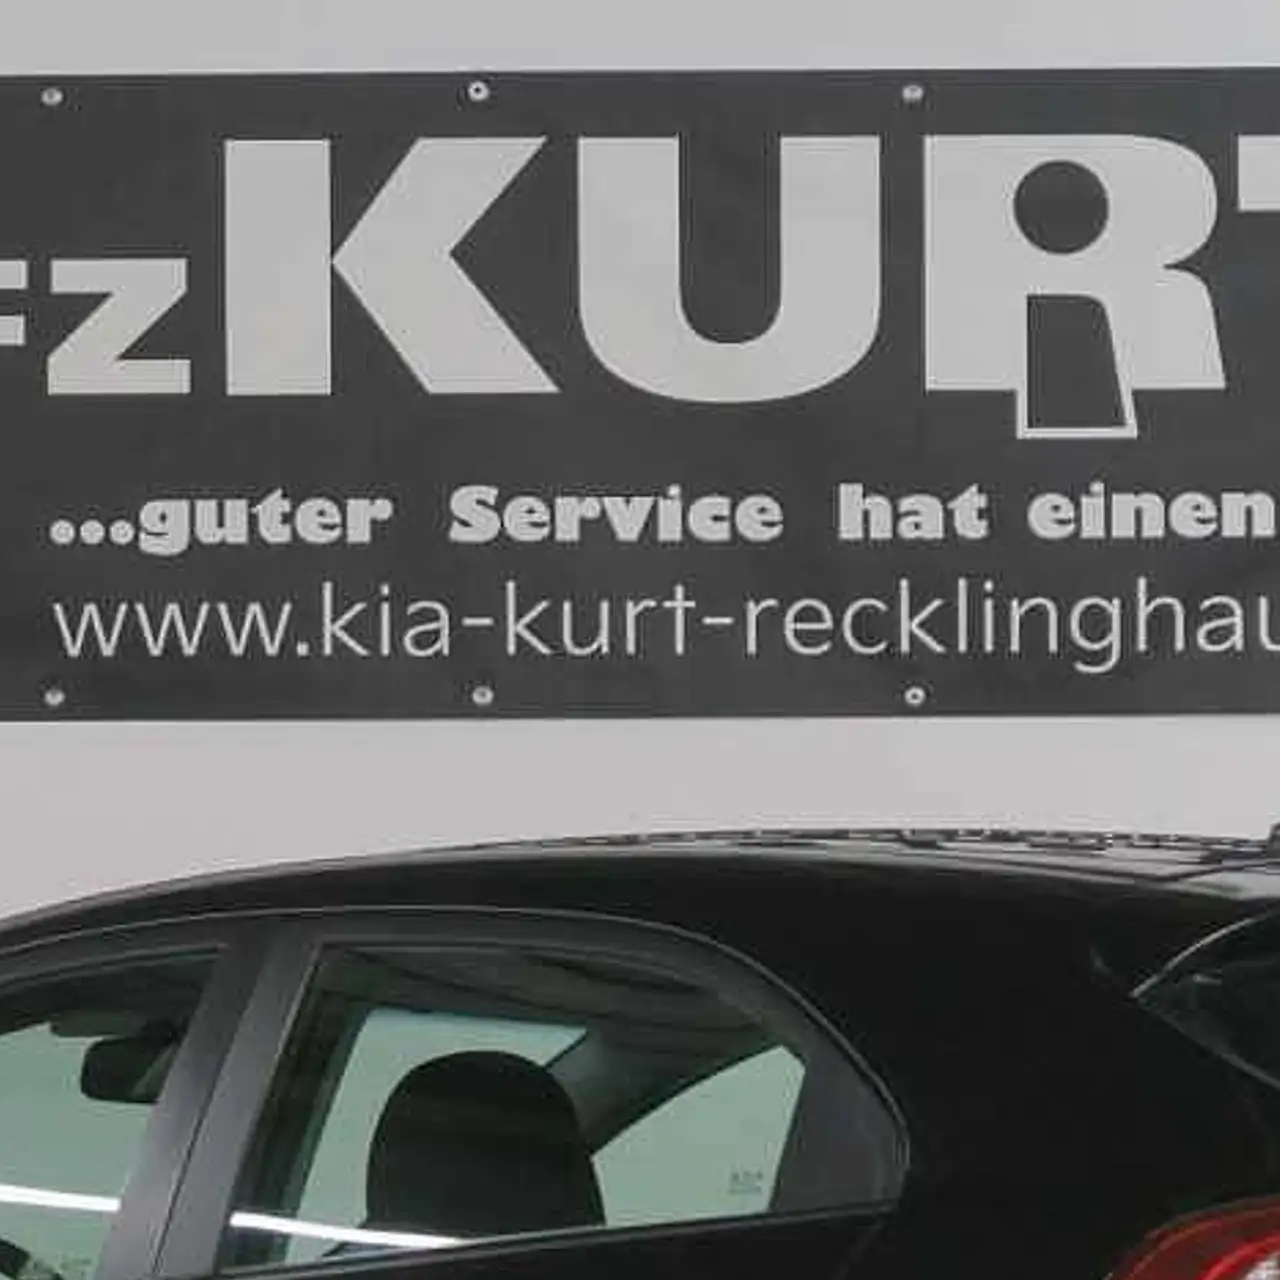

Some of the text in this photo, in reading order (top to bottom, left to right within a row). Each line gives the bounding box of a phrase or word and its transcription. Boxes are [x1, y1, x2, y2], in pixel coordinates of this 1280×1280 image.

[49, 488, 393, 556] ...guter
[448, 484, 784, 543] Service
[838, 482, 990, 541] hat
[1027, 481, 1277, 541] einen
